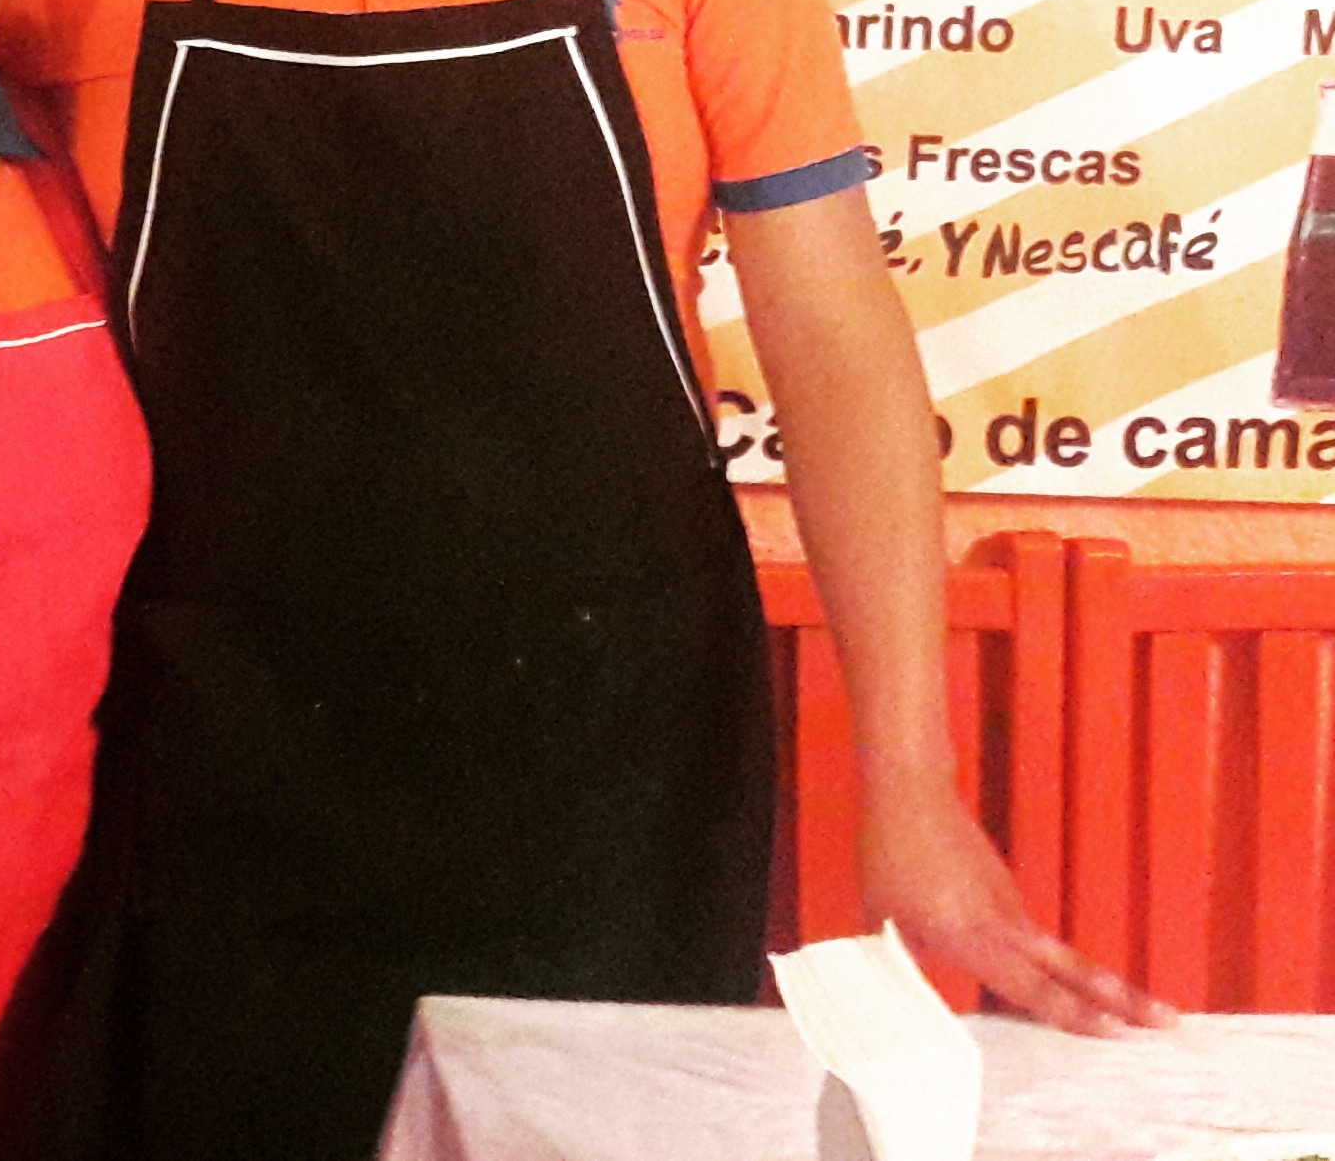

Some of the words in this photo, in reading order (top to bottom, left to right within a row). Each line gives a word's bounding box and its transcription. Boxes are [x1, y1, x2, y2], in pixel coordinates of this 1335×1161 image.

[1113, 6, 1223, 55] Uva
[908, 134, 1142, 185] Frescas
[981, 209, 1225, 278] Nescafé
[986, 398, 1092, 469] de
